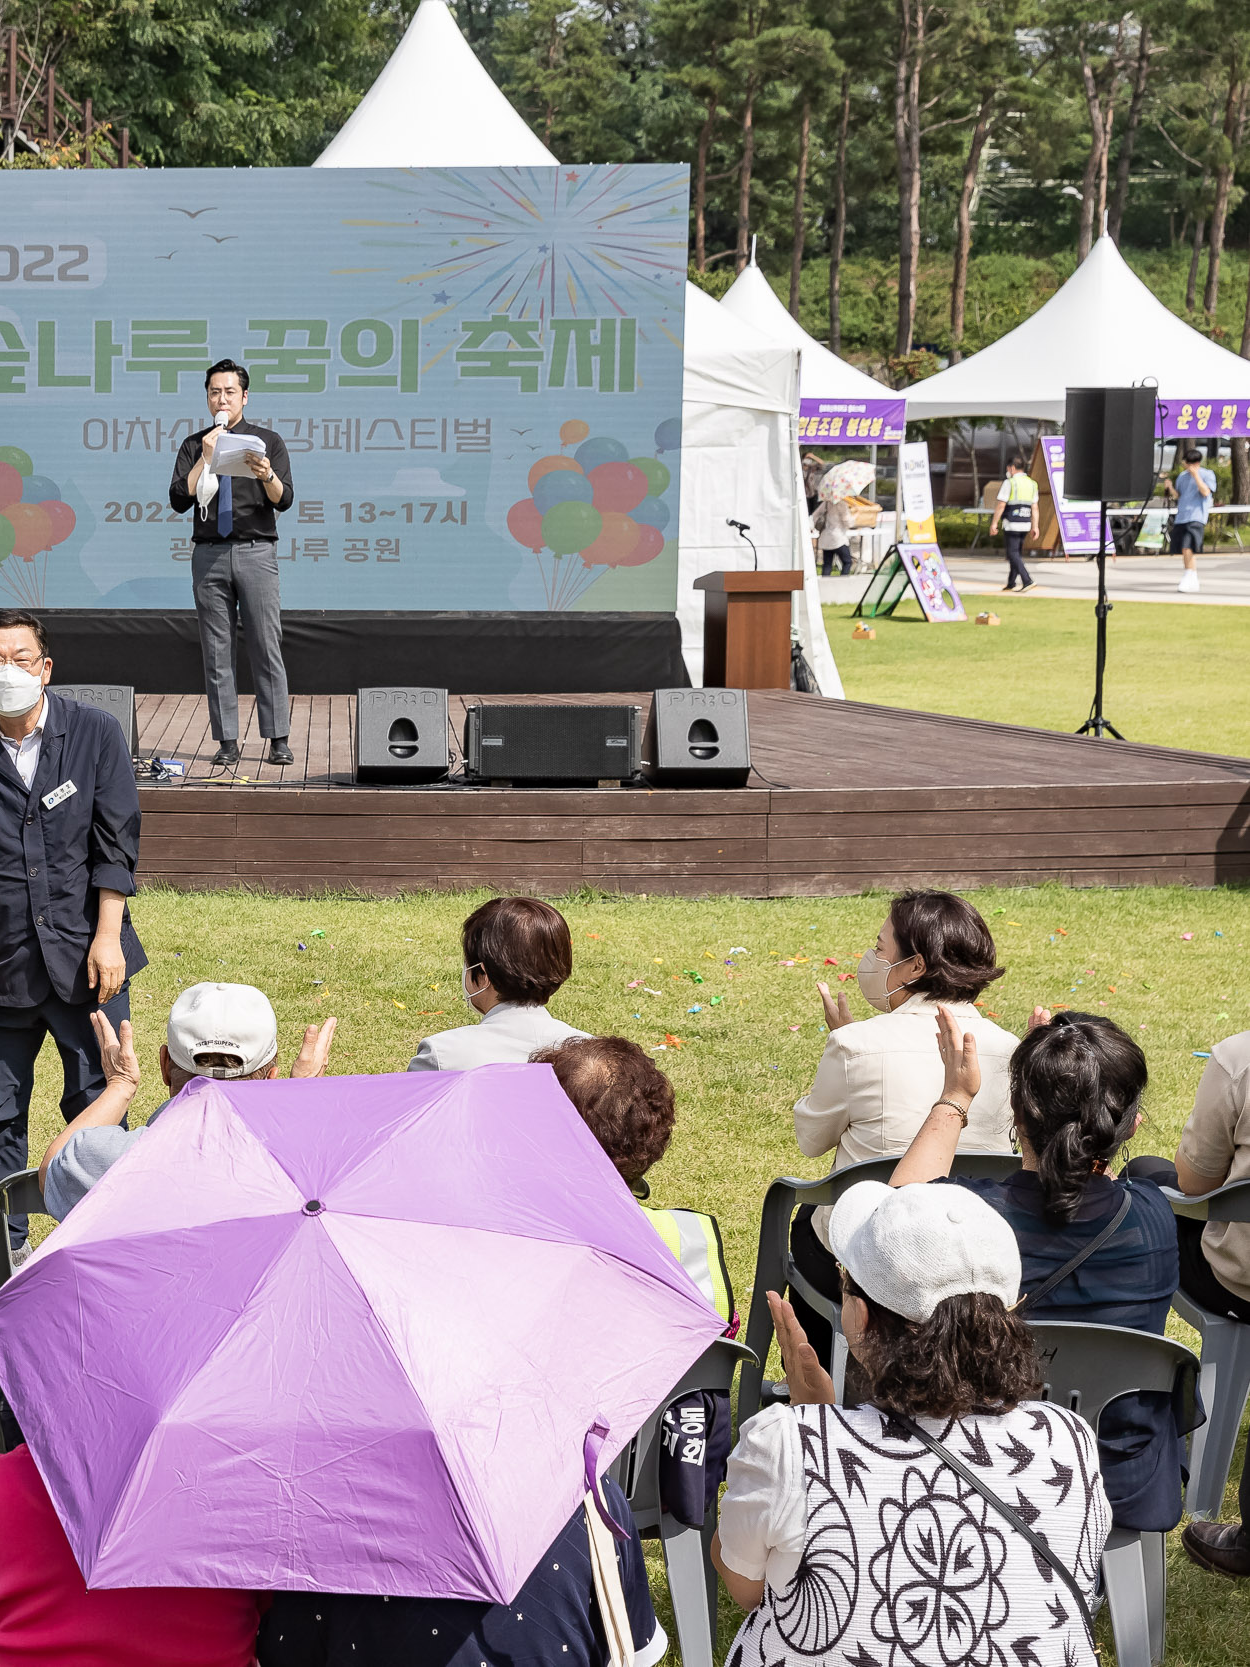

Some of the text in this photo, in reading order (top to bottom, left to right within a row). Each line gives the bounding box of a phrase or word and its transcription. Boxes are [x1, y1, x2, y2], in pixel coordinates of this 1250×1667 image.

[243, 318, 420, 394] 꿈의
[455, 313, 637, 394] 축제
[1176, 403, 1212, 431] 운영
[1220, 404, 1238, 430] 및
[296, 500, 326, 524] 토
[339, 500, 468, 526] 13~17시
[342, 537, 401, 563] 공원
